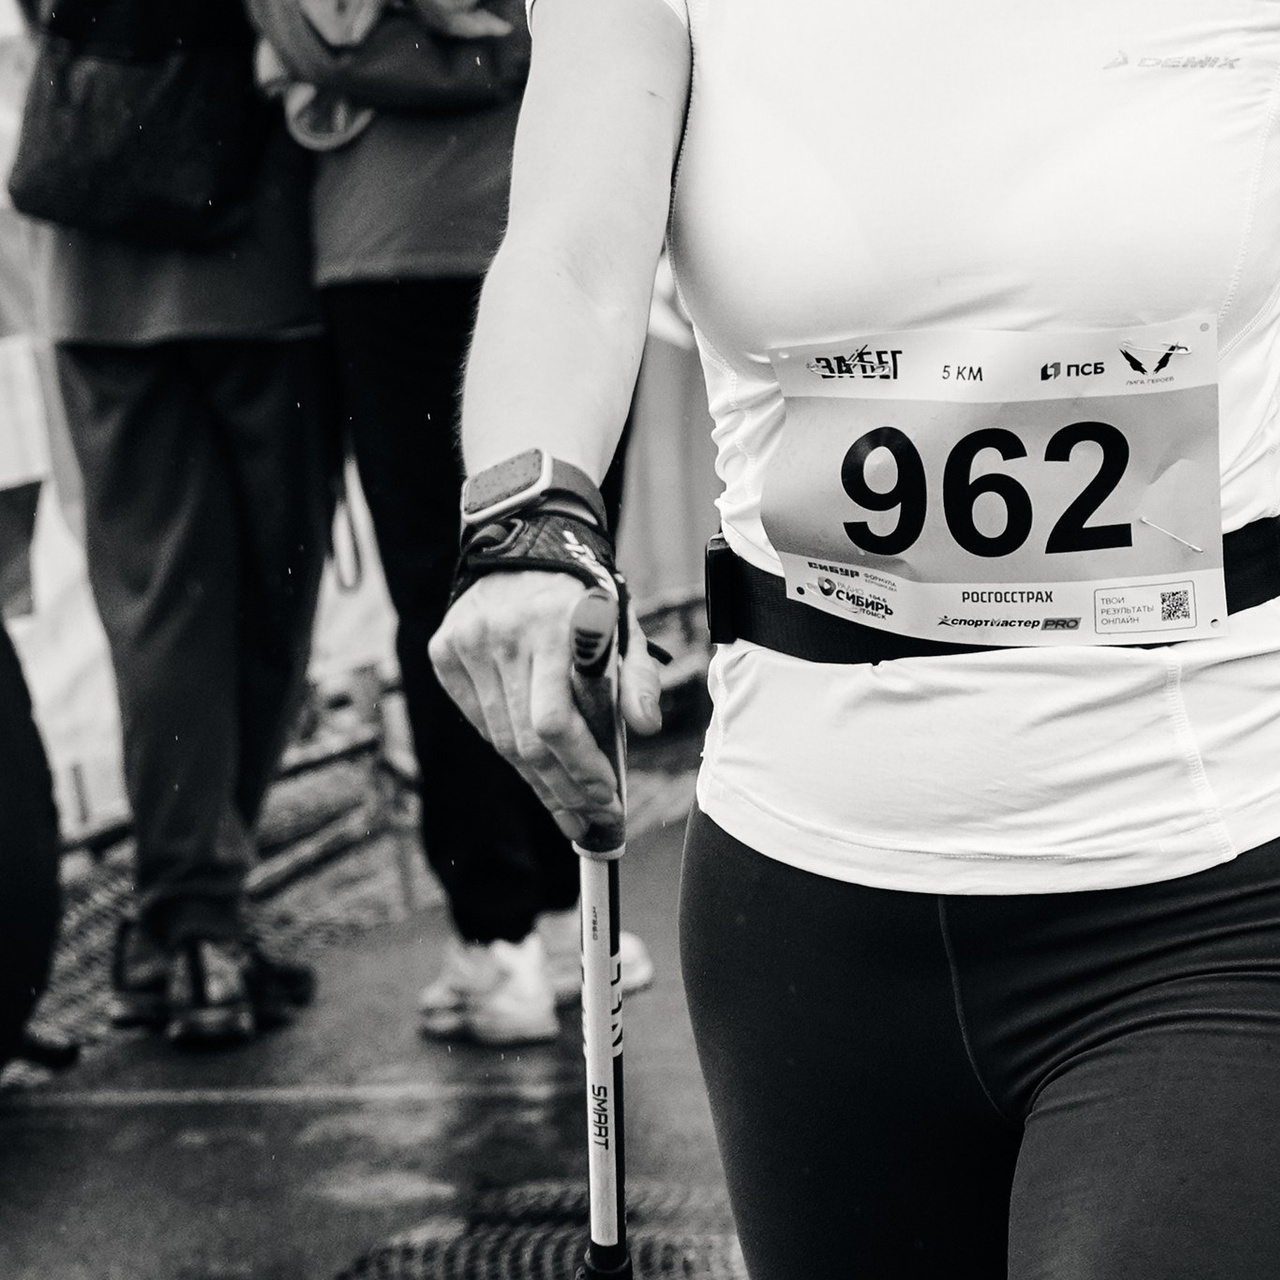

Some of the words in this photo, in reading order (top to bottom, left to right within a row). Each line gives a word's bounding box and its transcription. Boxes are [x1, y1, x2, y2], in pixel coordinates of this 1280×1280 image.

[942, 365, 951, 380] 5
[956, 366, 983, 381] КМ
[1067, 362, 1105, 377] ПСБ
[841, 421, 1132, 558] 962
[836, 590, 893, 615] СИБИРЬ
[962, 591, 1053, 603] РОСГОССТРАХ
[861, 608, 886, 620] ТОМСК
[1101, 605, 1154, 616] РЕЗУЛЬТАТЫ
[1044, 619, 1079, 629] PRO
[1101, 615, 1140, 626] ОНЛАЙН
[591, 1084, 609, 1151] SMART
